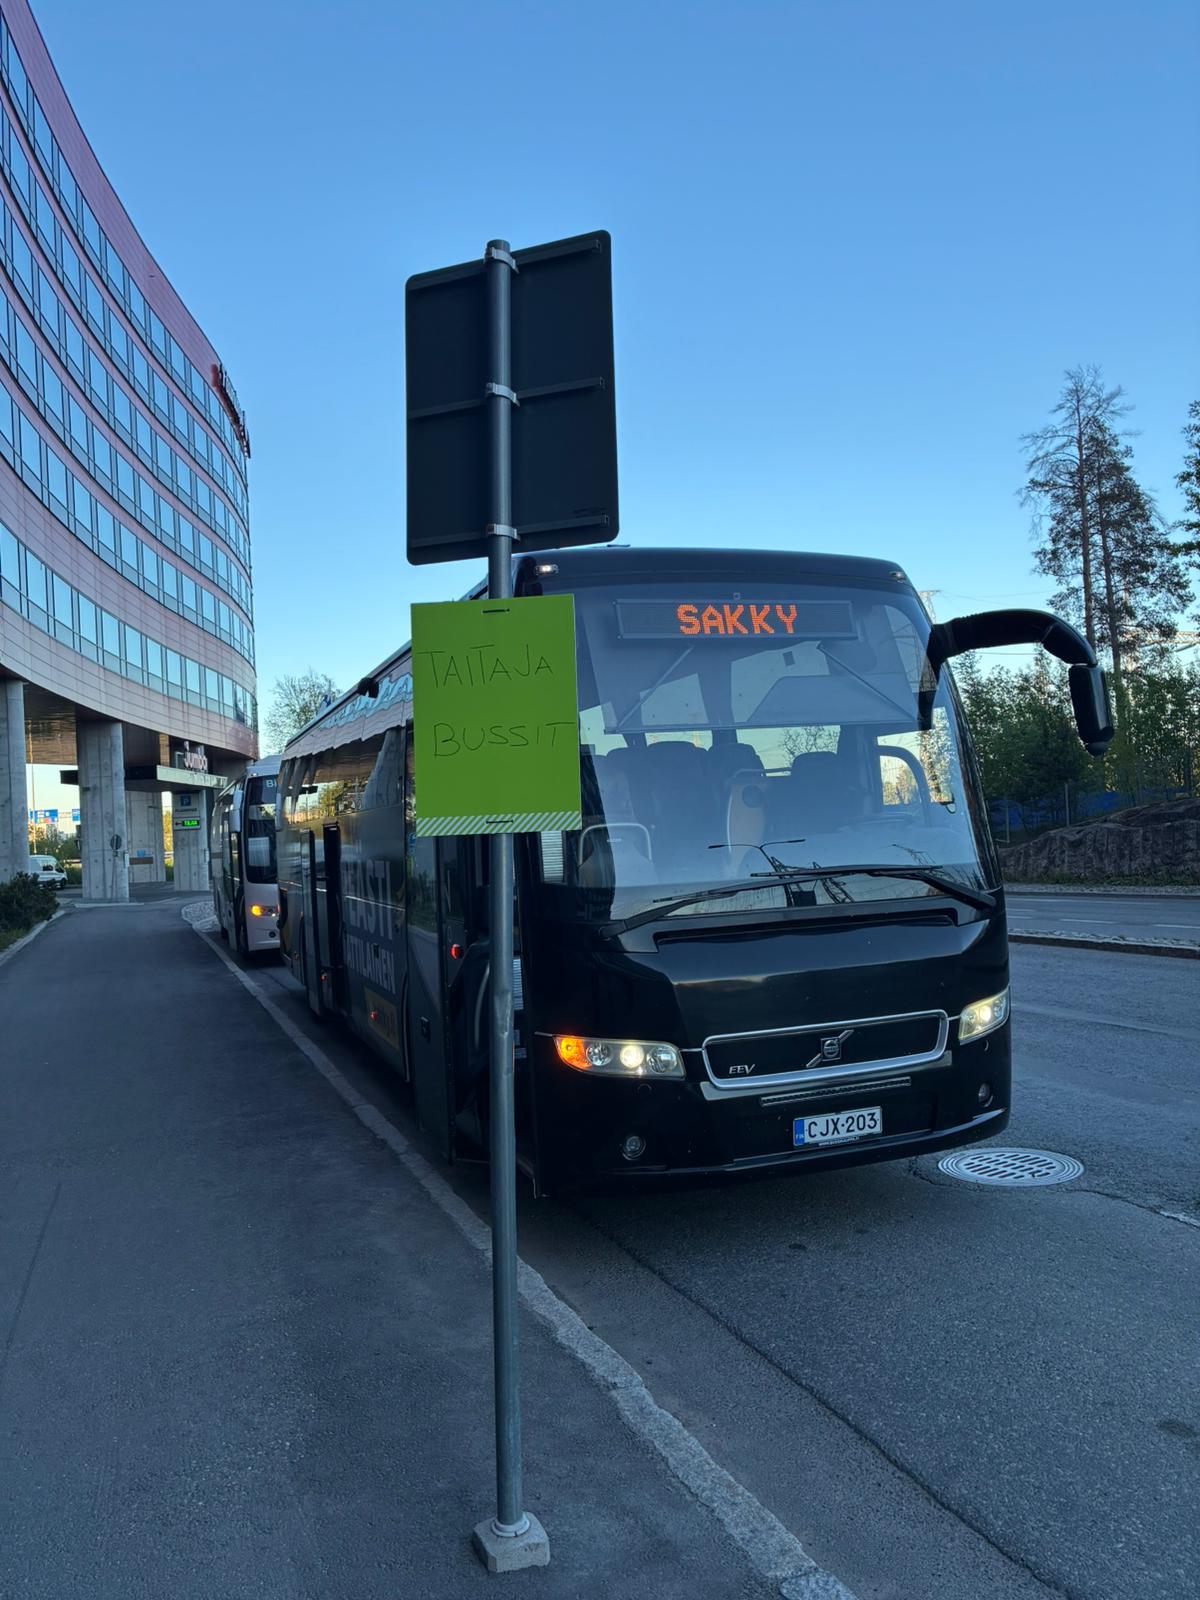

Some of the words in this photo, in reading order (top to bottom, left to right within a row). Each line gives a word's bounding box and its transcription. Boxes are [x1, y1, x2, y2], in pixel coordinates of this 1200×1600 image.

[676, 603, 798, 636] SAKKY
[415, 644, 553, 688] TAITAJA
[433, 721, 576, 758] BUSSIT
[728, 1064, 756, 1075] EEV
[808, 1112, 878, 1138] CJX-203
